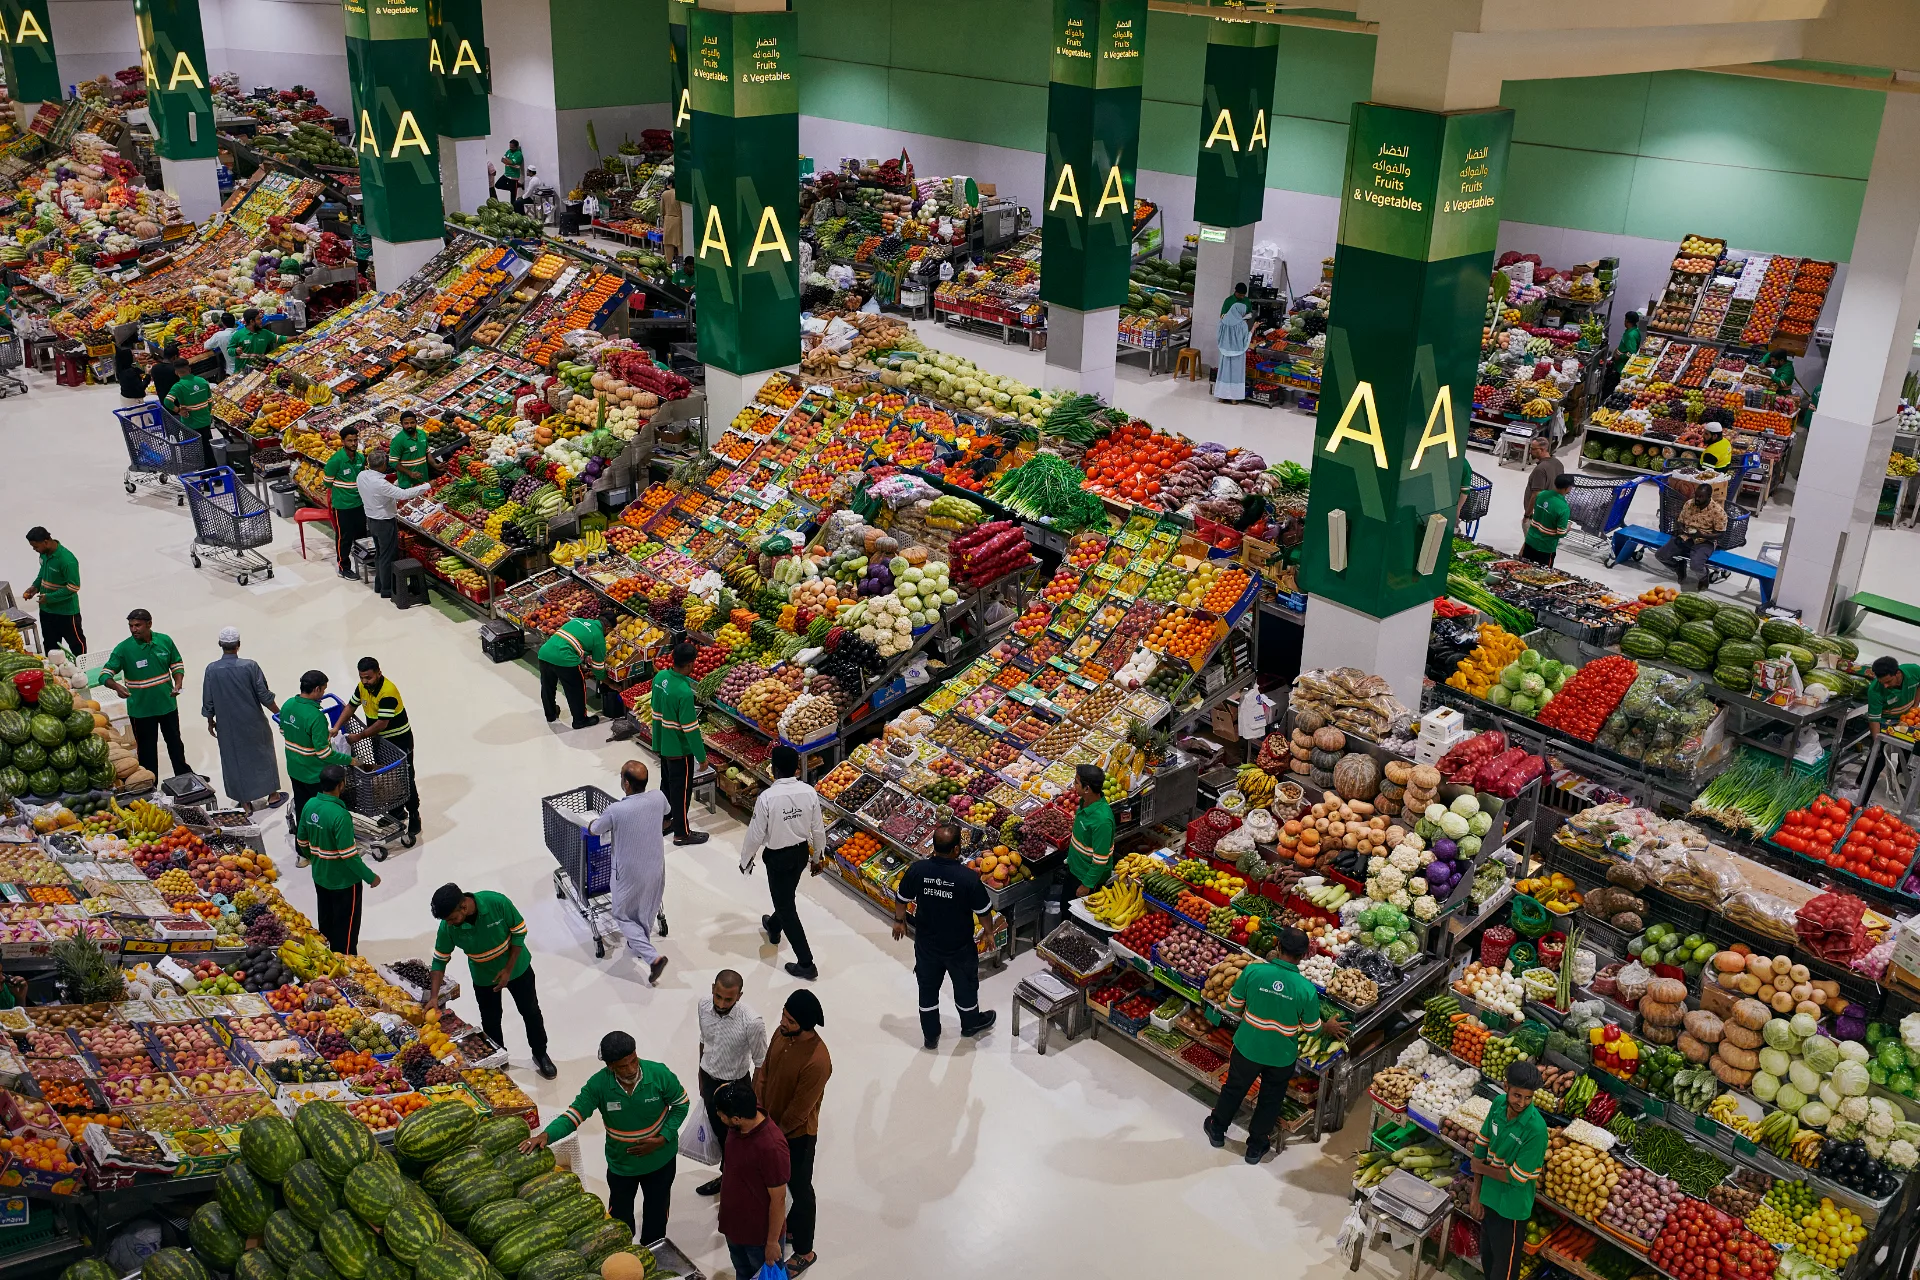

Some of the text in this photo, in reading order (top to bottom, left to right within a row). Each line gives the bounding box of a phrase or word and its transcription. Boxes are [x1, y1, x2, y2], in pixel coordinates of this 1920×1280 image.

[382, 6, 419, 16] Vegetables
[16, 10, 48, 43] A
[755, 37, 777, 49] الخضار
[1061, 47, 1092, 59] Vegetables
[1066, 38, 1082, 47] Fruits
[1114, 40, 1130, 48] Fruits
[430, 38, 445, 75] A
[452, 39, 482, 75] A
[703, 58, 718, 68] Fruits
[1109, 49, 1139, 60] Vegetables
[146, 51, 160, 90] A
[169, 52, 204, 91] A
[699, 70, 728, 82] Vegetables
[756, 61, 777, 70] Fruits
[742, 72, 791, 84] & Vegetables
[360, 109, 380, 158] A
[391, 110, 432, 158] A
[1205, 108, 1240, 152] A
[1248, 108, 1267, 152] A
[1378, 142, 1409, 158] الخضار
[1465, 147, 1489, 163] الخضار
[1372, 160, 1411, 178] والفواكه
[1049, 163, 1083, 217] A
[1095, 165, 1128, 218] A
[1375, 175, 1404, 191] Fruits
[1461, 181, 1483, 194] Fruits
[1353, 188, 1423, 212] & Vegetables
[1444, 195, 1495, 213] & Vegetables
[700, 204, 732, 267] A
[748, 205, 792, 267] A
[1324, 380, 1389, 470] A
[1410, 384, 1458, 471] A
